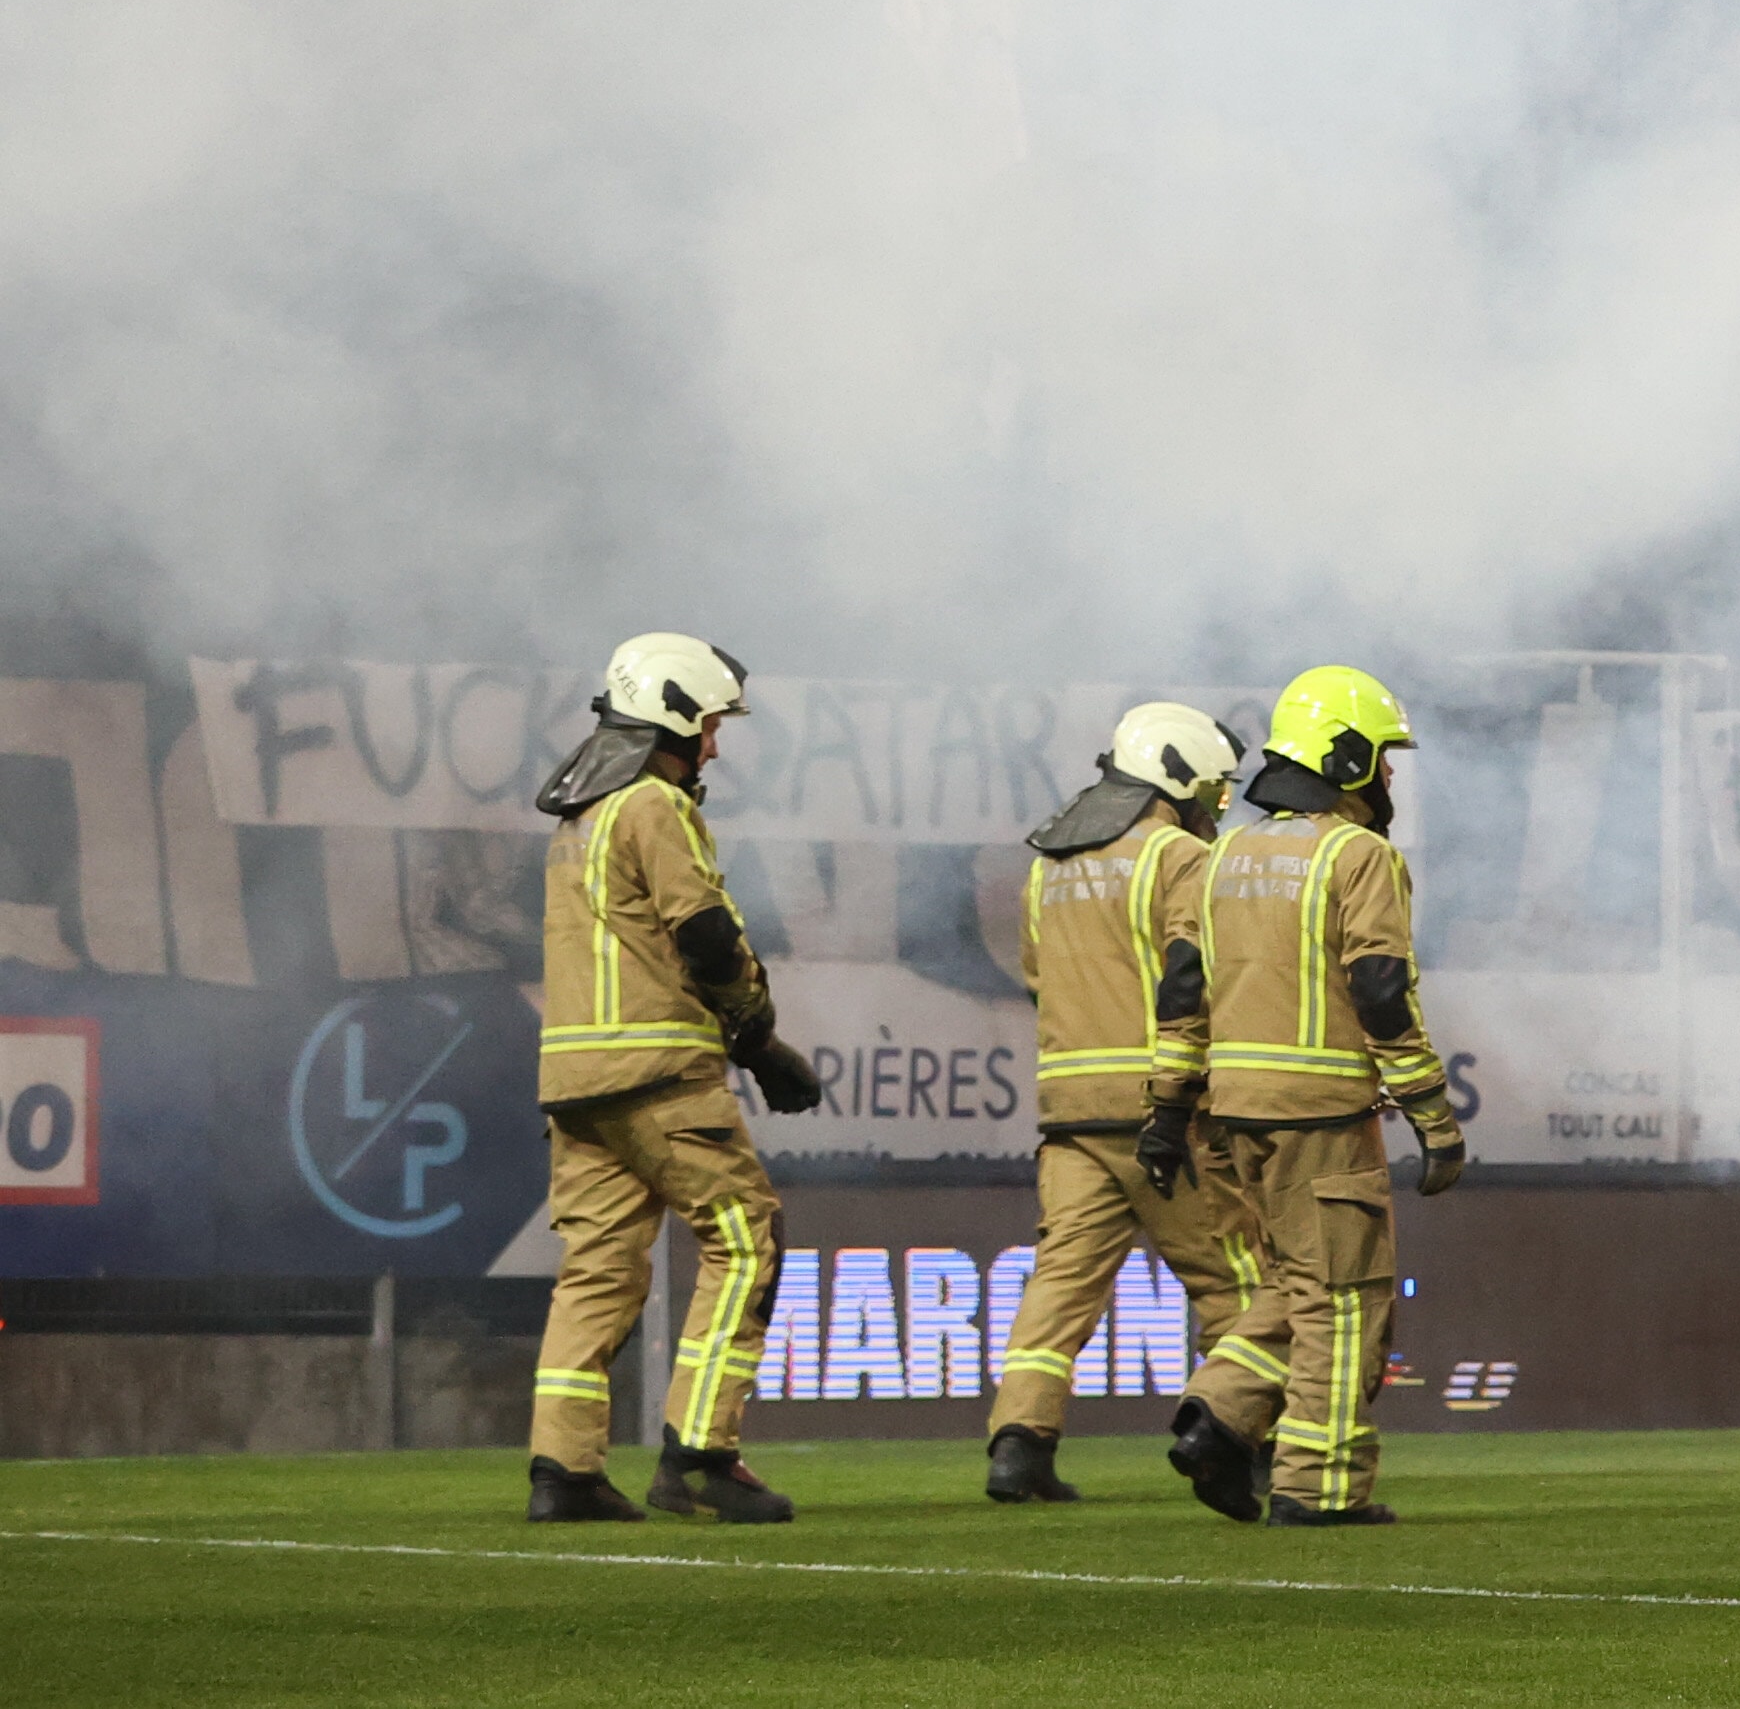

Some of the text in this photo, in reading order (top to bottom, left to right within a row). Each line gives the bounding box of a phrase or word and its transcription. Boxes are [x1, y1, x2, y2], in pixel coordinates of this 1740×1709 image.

[612, 662, 640, 704] AXEL
[230, 657, 602, 818] FUCK
[727, 1024, 1021, 1121] RIÈRES
[1547, 1113, 1605, 1140] TOUT
